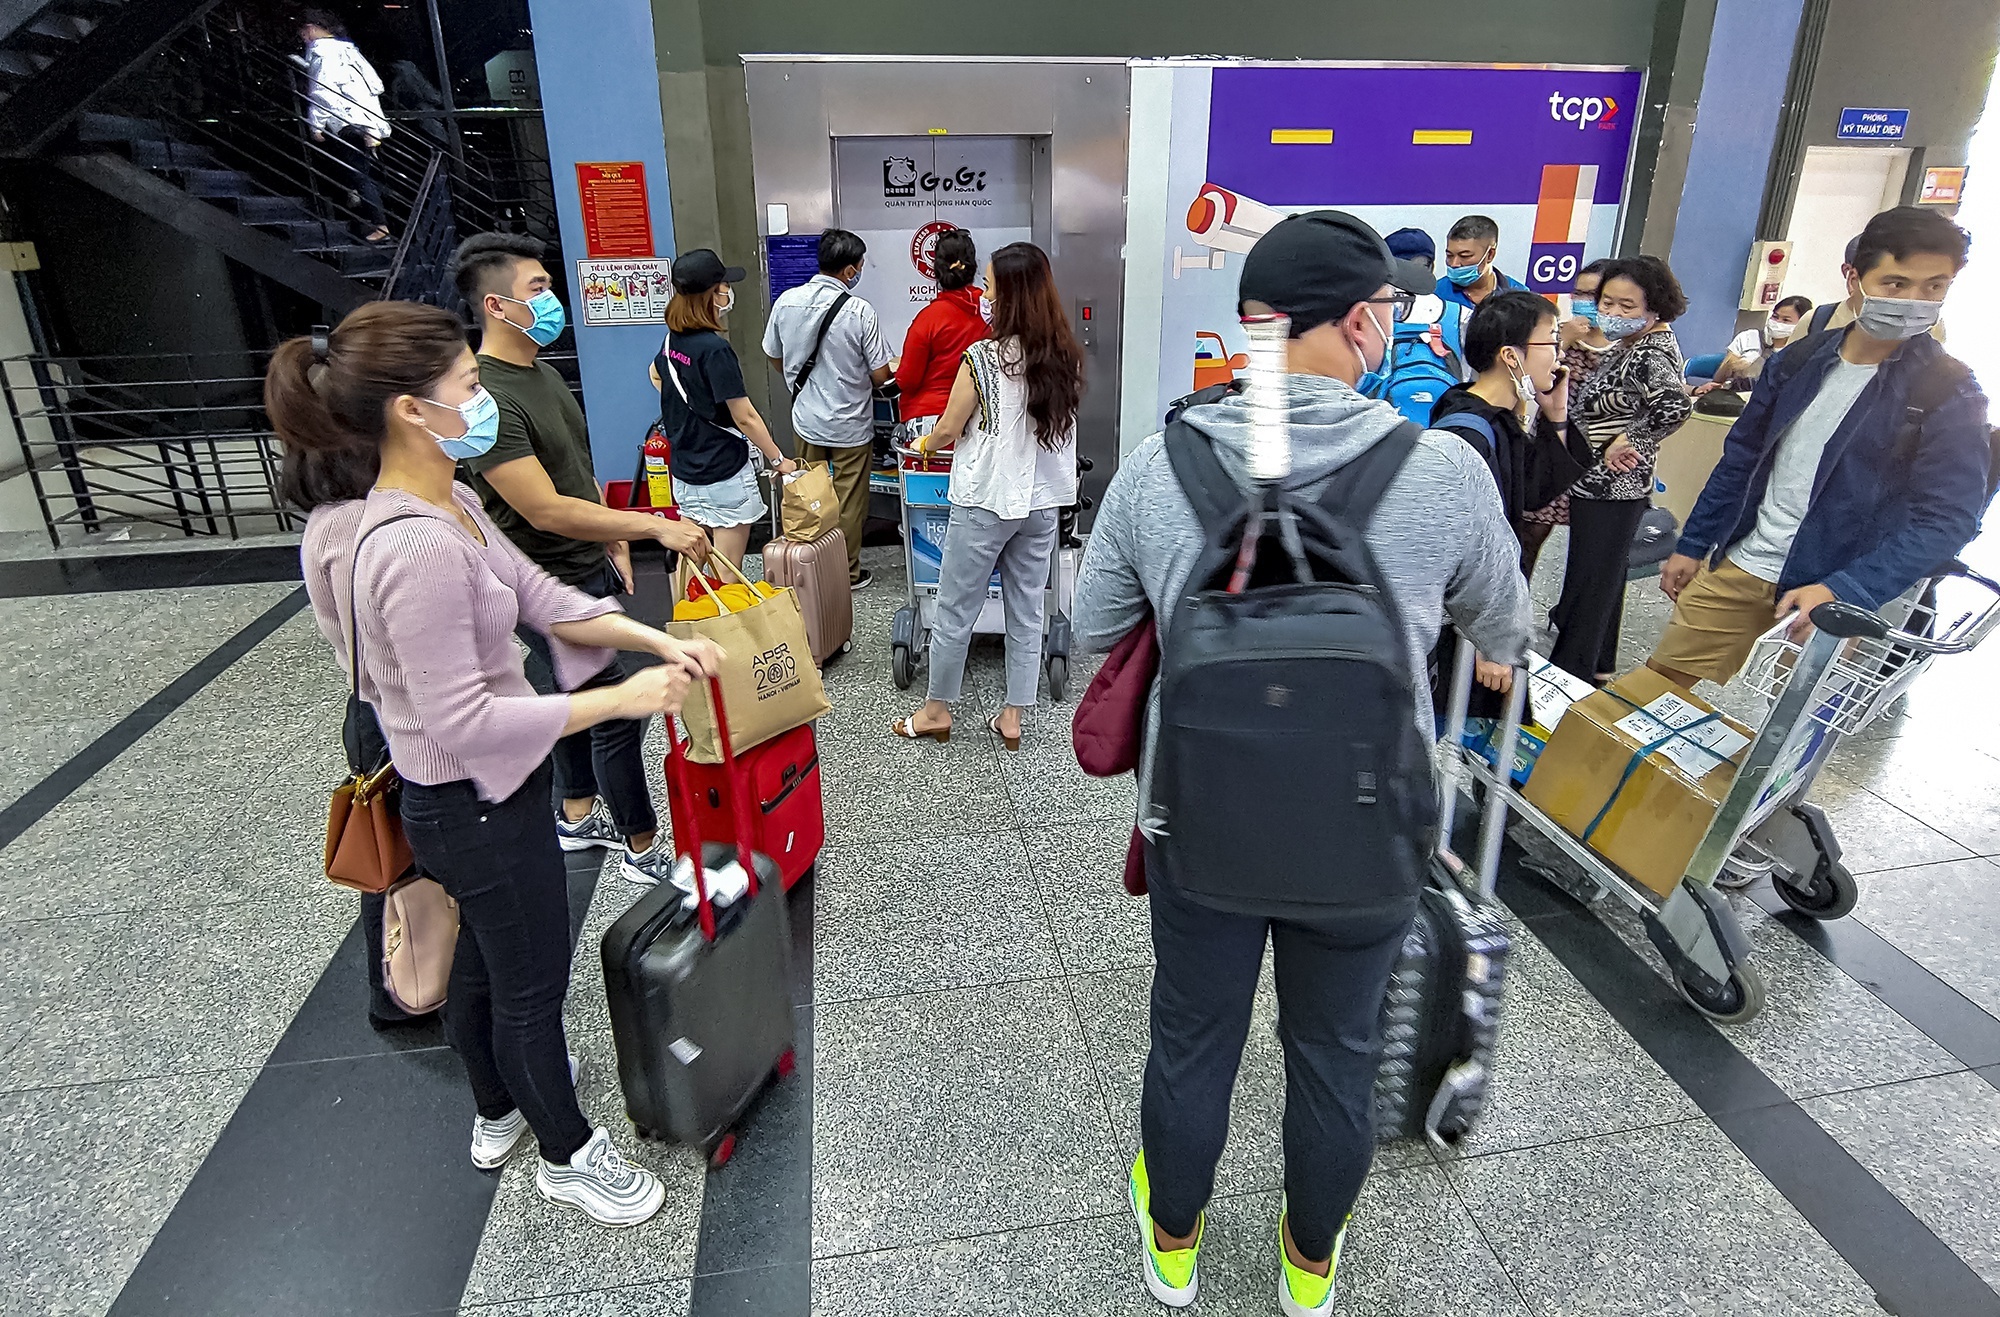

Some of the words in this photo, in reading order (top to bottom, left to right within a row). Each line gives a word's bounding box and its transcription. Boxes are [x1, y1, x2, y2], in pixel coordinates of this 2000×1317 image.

[1548, 91, 1603, 130] tcp
[1533, 255, 1577, 282] G9
[909, 286, 936, 295] KICH
[934, 488, 948, 498] Vi
